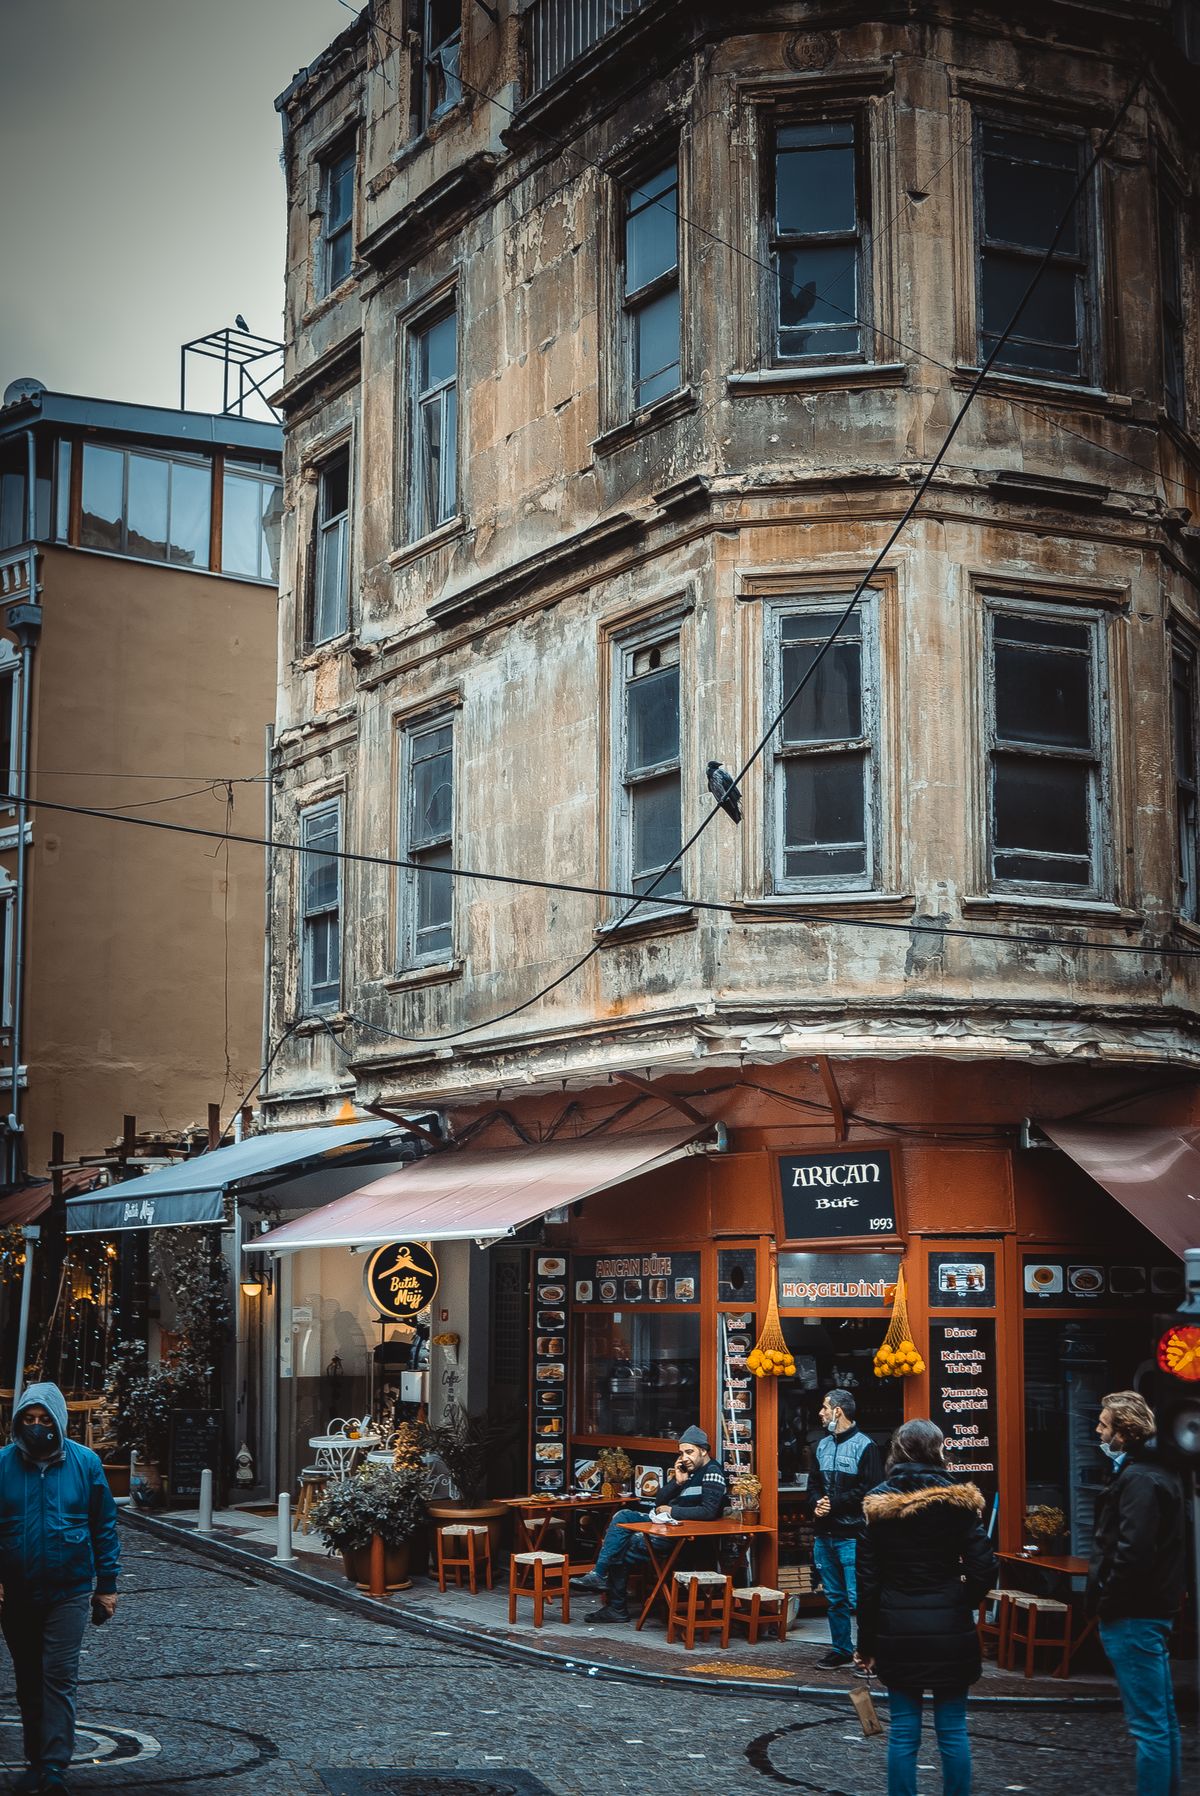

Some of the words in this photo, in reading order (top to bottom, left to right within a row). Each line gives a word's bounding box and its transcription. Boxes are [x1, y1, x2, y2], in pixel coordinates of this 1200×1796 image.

[816, 1197, 860, 1209] Büfe
[869, 1218, 894, 1230] 1993
[595, 1259, 641, 1278] ARICAN
[642, 1252, 672, 1276] BÜFE
[390, 1276, 421, 1291] Butik
[944, 1328, 977, 1338] Döner
[941, 1350, 986, 1361] Kahvaltı
[945, 1362, 983, 1375] Tabağı
[941, 1387, 988, 1398] Yumurta
[942, 1399, 988, 1413] Çeşitleri
[953, 1424, 979, 1435] Tost
[944, 1436, 989, 1450] Çeşitleri
